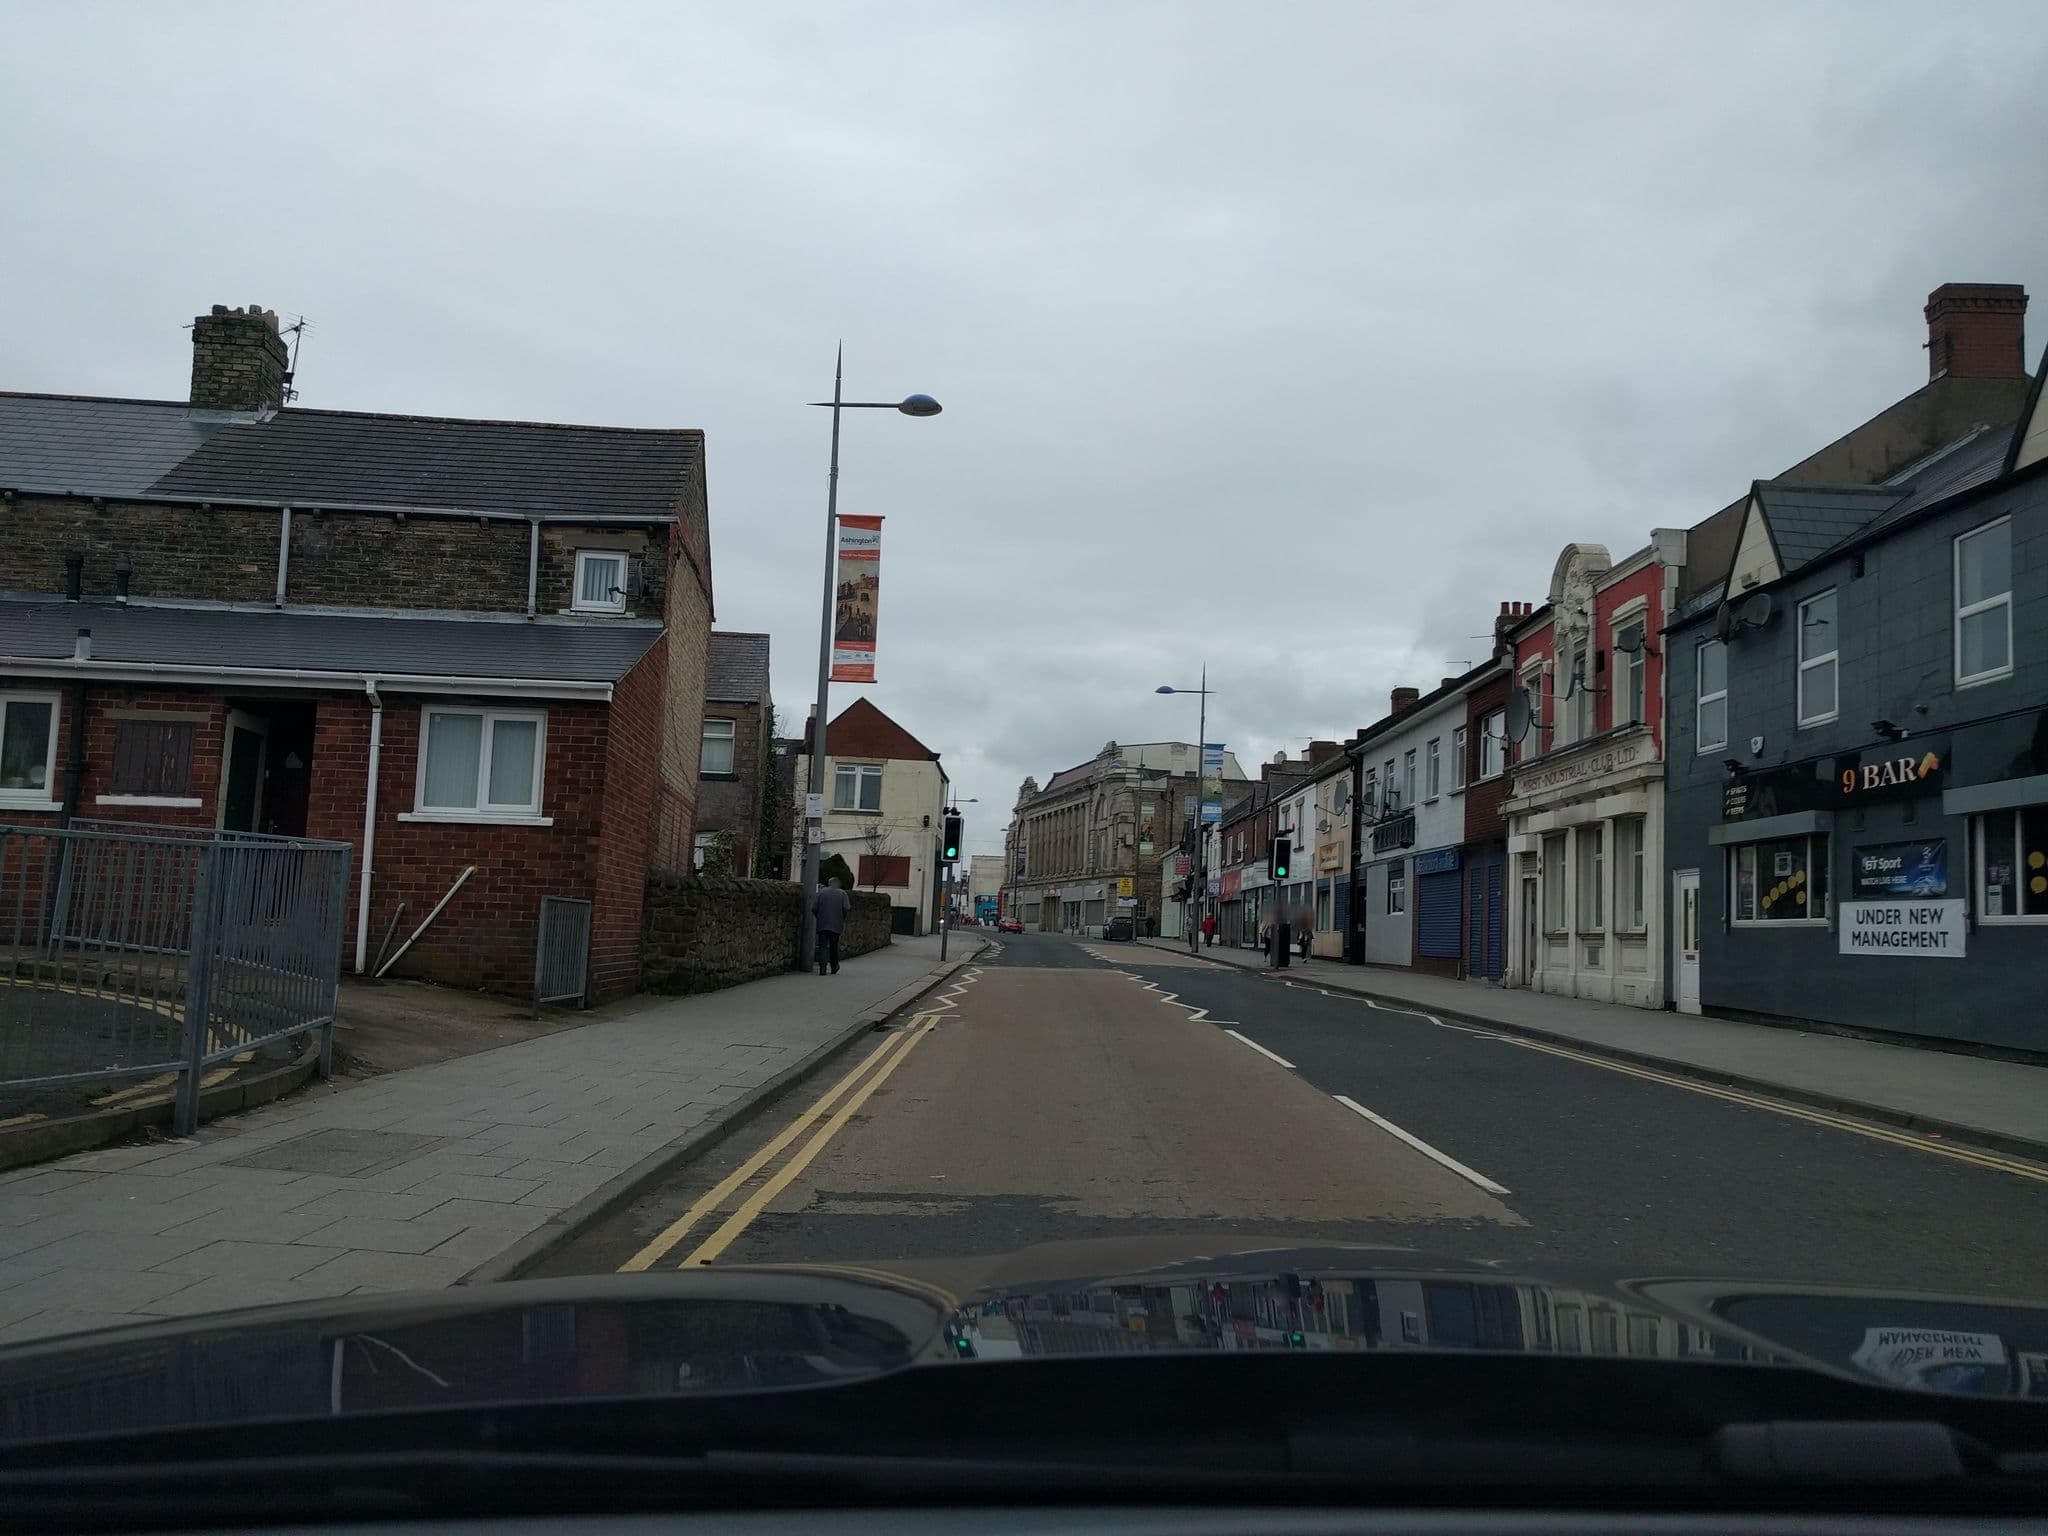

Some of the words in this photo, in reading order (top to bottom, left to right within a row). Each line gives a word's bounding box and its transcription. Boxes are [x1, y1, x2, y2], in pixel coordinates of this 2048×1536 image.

[840, 536, 871, 545] Ashington
[1591, 753, 1614, 773] CLUB
[1617, 746, 1636, 765] LTD
[1842, 769, 1856, 794] 9
[1862, 756, 1918, 791] BAR
[1878, 856, 1903, 871] Sport
[1855, 909, 1902, 925] UNDER
[1909, 907, 1944, 925] NEW
[1851, 930, 1949, 948] MANAGEMENT
